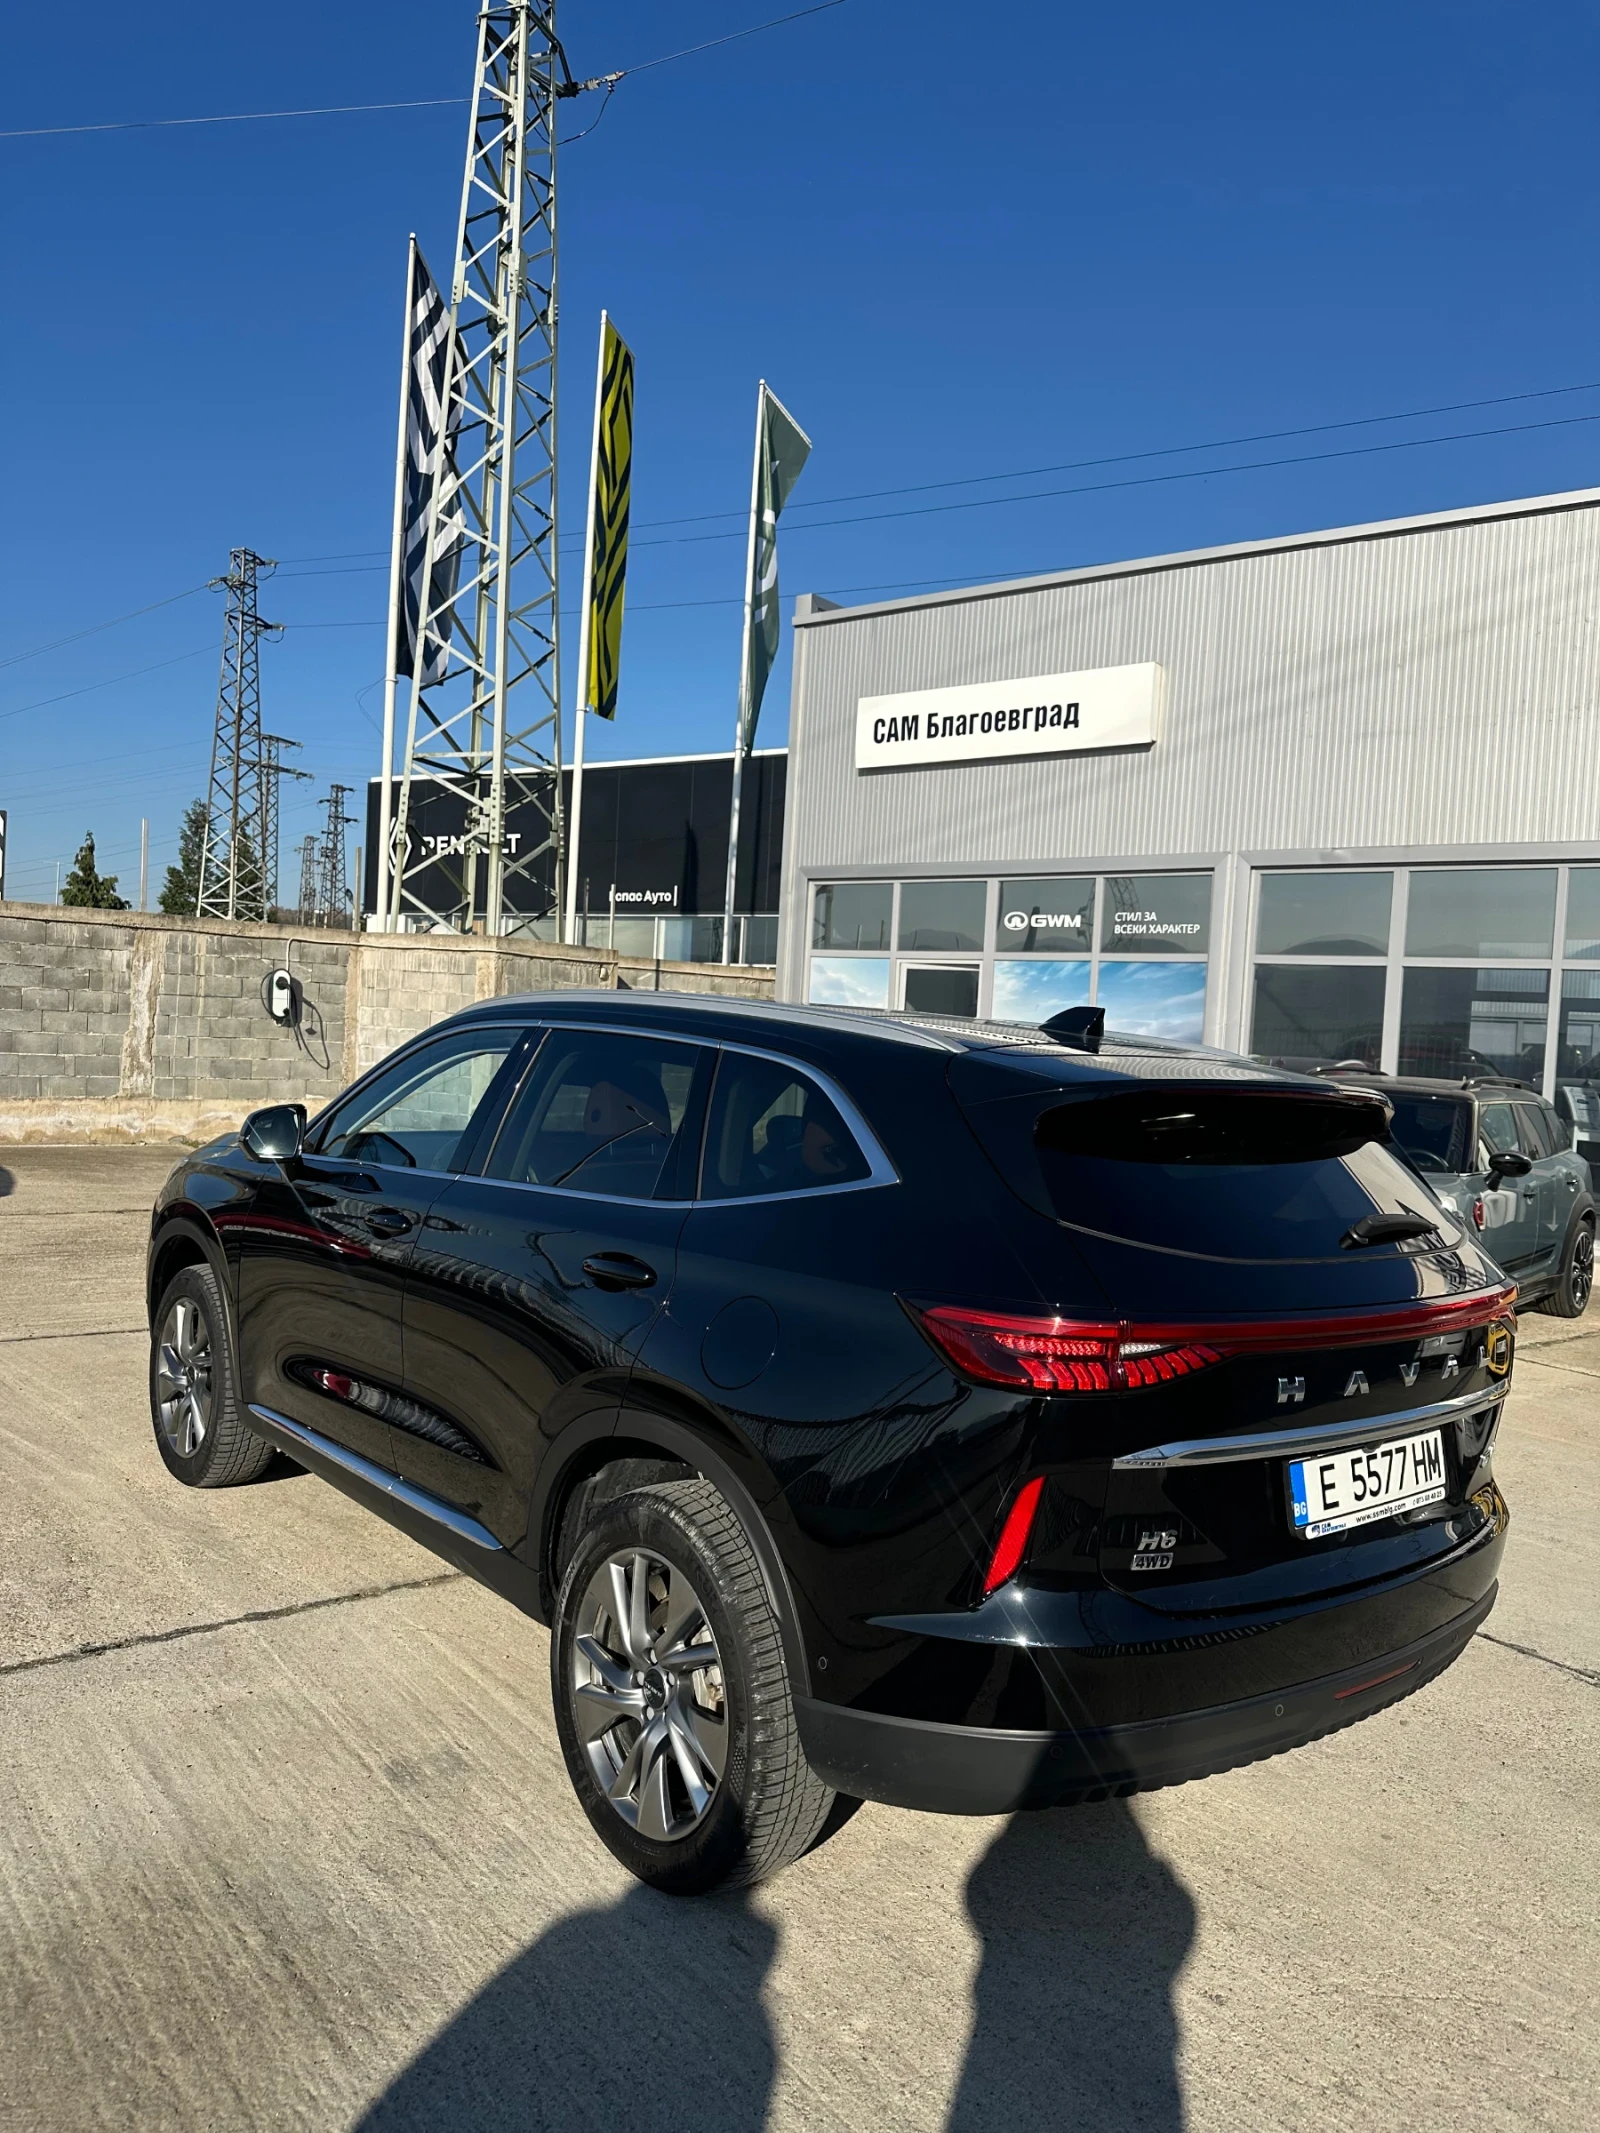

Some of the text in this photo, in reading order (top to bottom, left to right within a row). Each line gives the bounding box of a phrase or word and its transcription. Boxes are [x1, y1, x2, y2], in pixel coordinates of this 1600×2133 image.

[873, 702, 1080, 744] САМ Благоевград
[643, 889, 672, 905] Ауто
[1030, 914, 1082, 928] GWM
[1114, 911, 1157, 922] СТИЛ ЗА
[1114, 923, 1200, 934] ВСЕКИ ХАРАКТЕР
[1277, 1345, 1490, 1403] HAVAL
[1319, 1463, 1339, 1511] E
[1350, 1446, 1407, 1502] 5577
[1412, 1437, 1441, 1486] HM
[1293, 1502, 1307, 1517] BG
[1137, 1529, 1178, 1551] H6
[1135, 1555, 1170, 1569] 4WD
